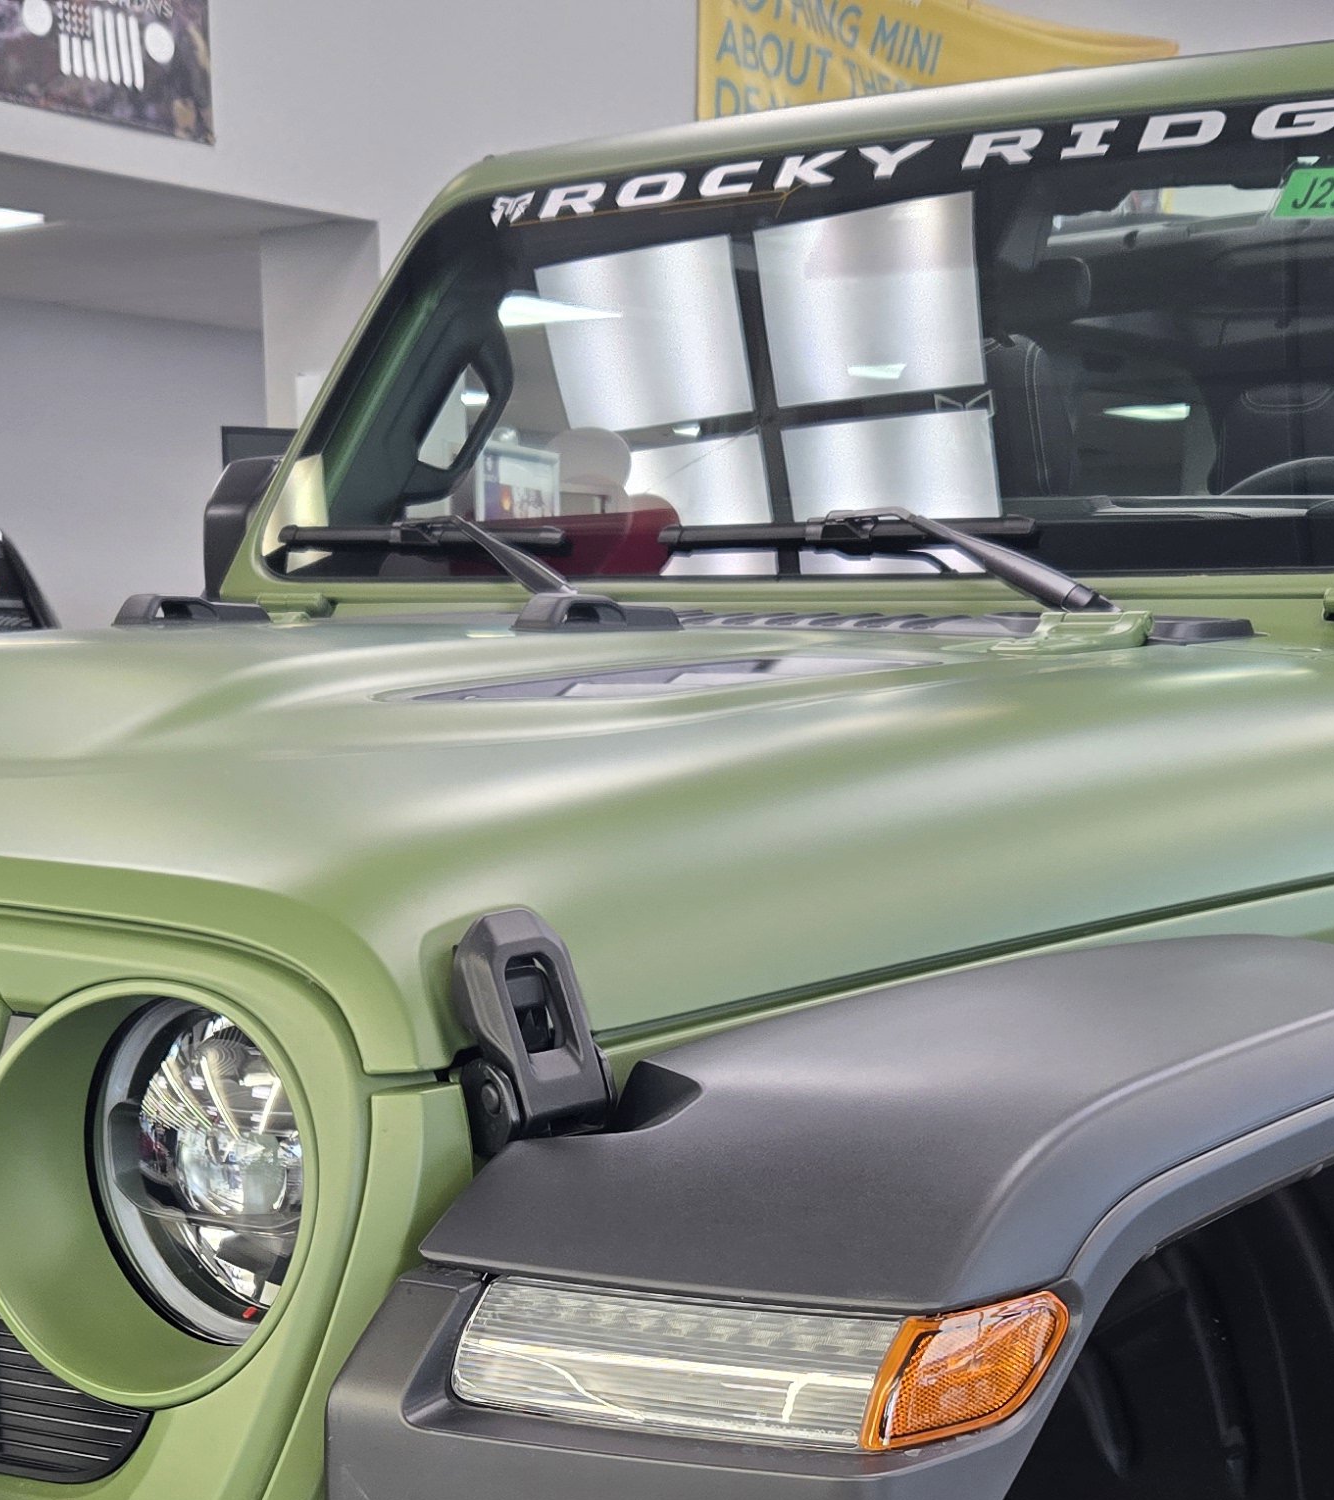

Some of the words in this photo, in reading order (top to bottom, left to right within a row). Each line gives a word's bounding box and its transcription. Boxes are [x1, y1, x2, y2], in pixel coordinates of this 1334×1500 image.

[717, 19, 833, 92] ABOUT
[869, 14, 943, 76] MINI
[539, 140, 934, 221] ROCKY
